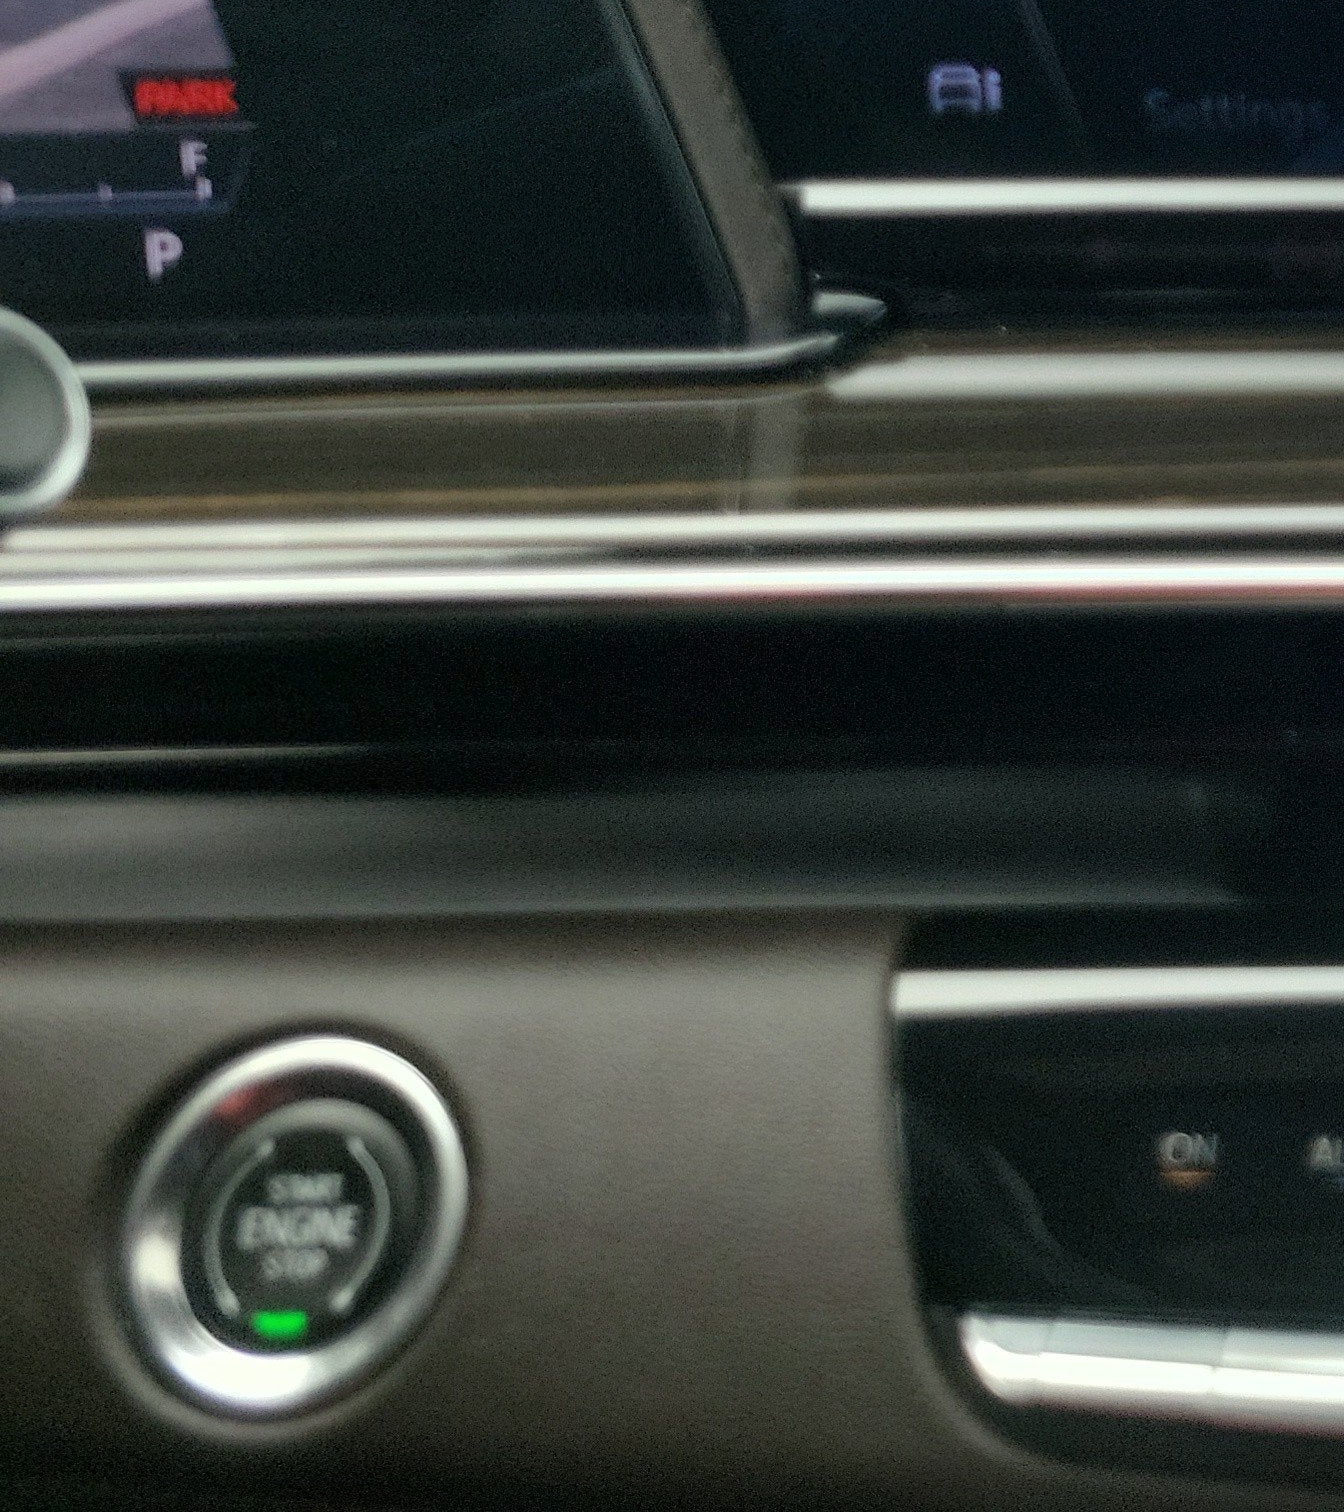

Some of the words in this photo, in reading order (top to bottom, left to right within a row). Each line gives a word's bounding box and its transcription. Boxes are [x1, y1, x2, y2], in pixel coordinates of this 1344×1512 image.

[134, 78, 238, 116] PARK
[180, 140, 208, 179] F
[144, 228, 184, 283] P
